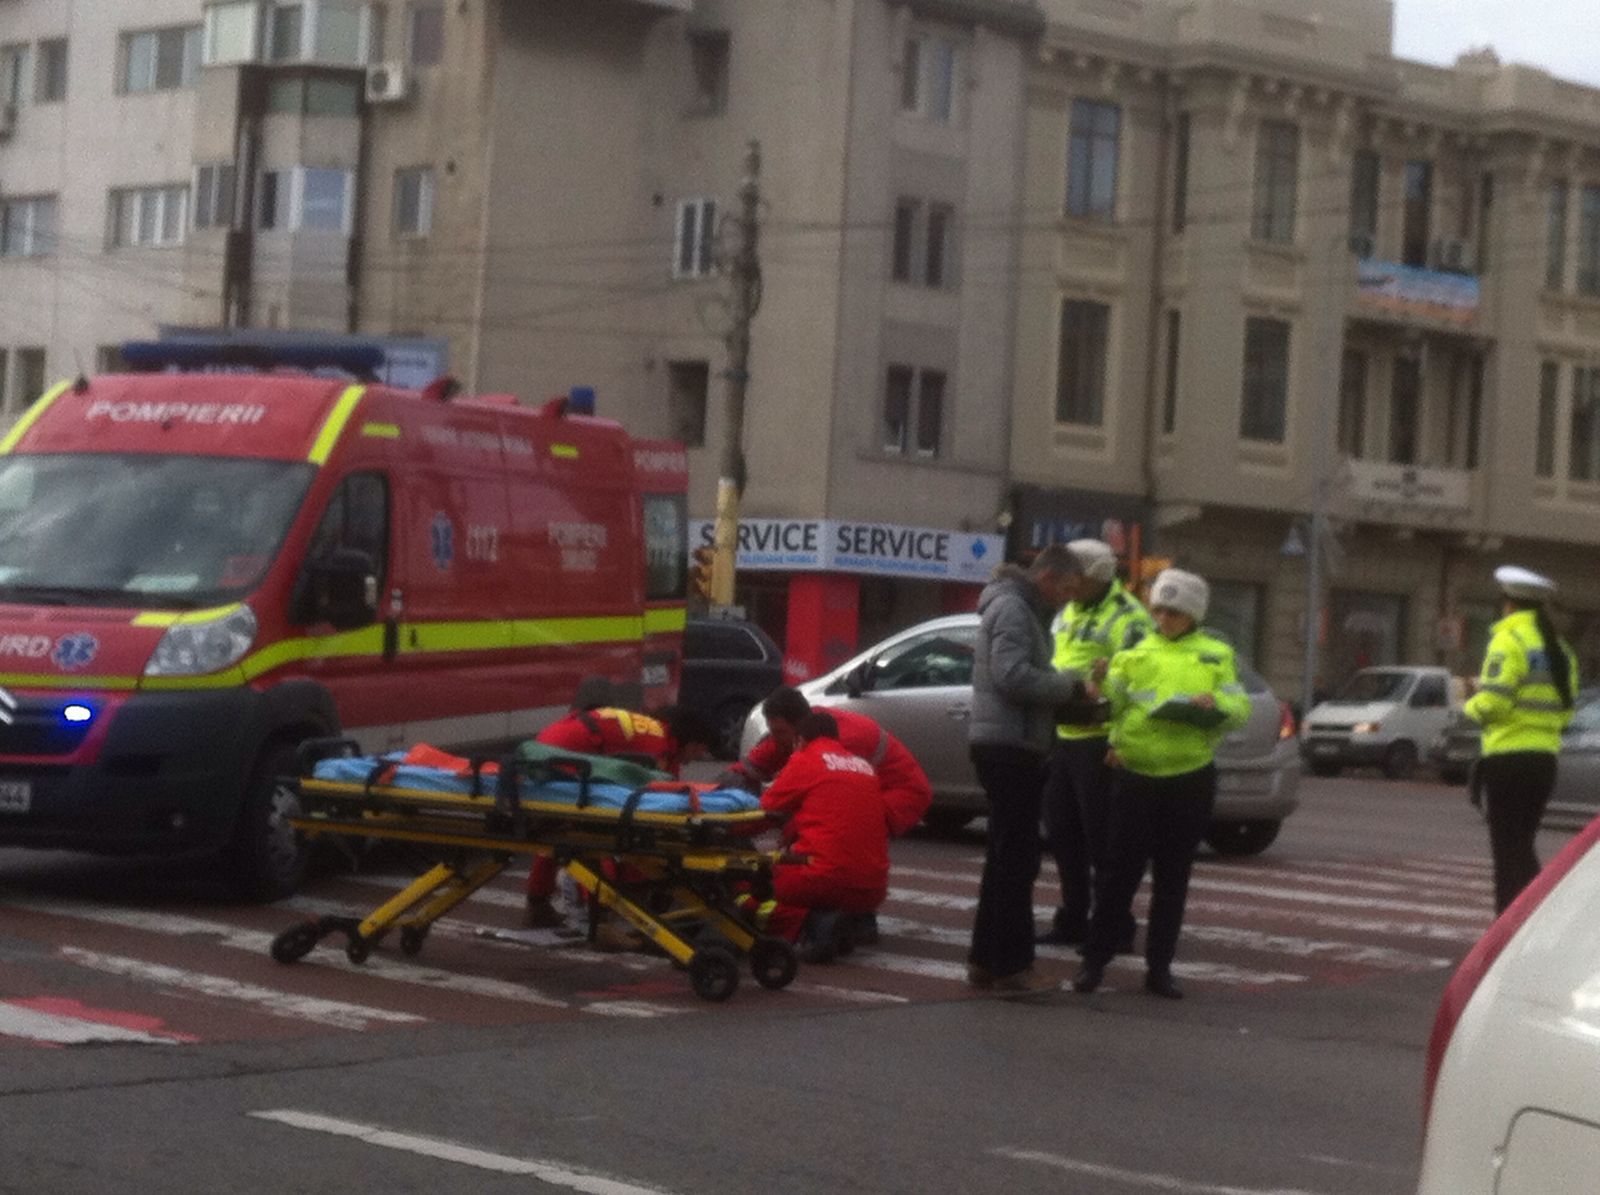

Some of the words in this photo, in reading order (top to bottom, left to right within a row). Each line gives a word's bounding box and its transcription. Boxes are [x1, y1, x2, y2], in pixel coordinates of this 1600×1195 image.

[85, 402, 266, 424] POMPIERII
[701, 523, 818, 551] SRVICE
[836, 525, 950, 561] SERVICE
